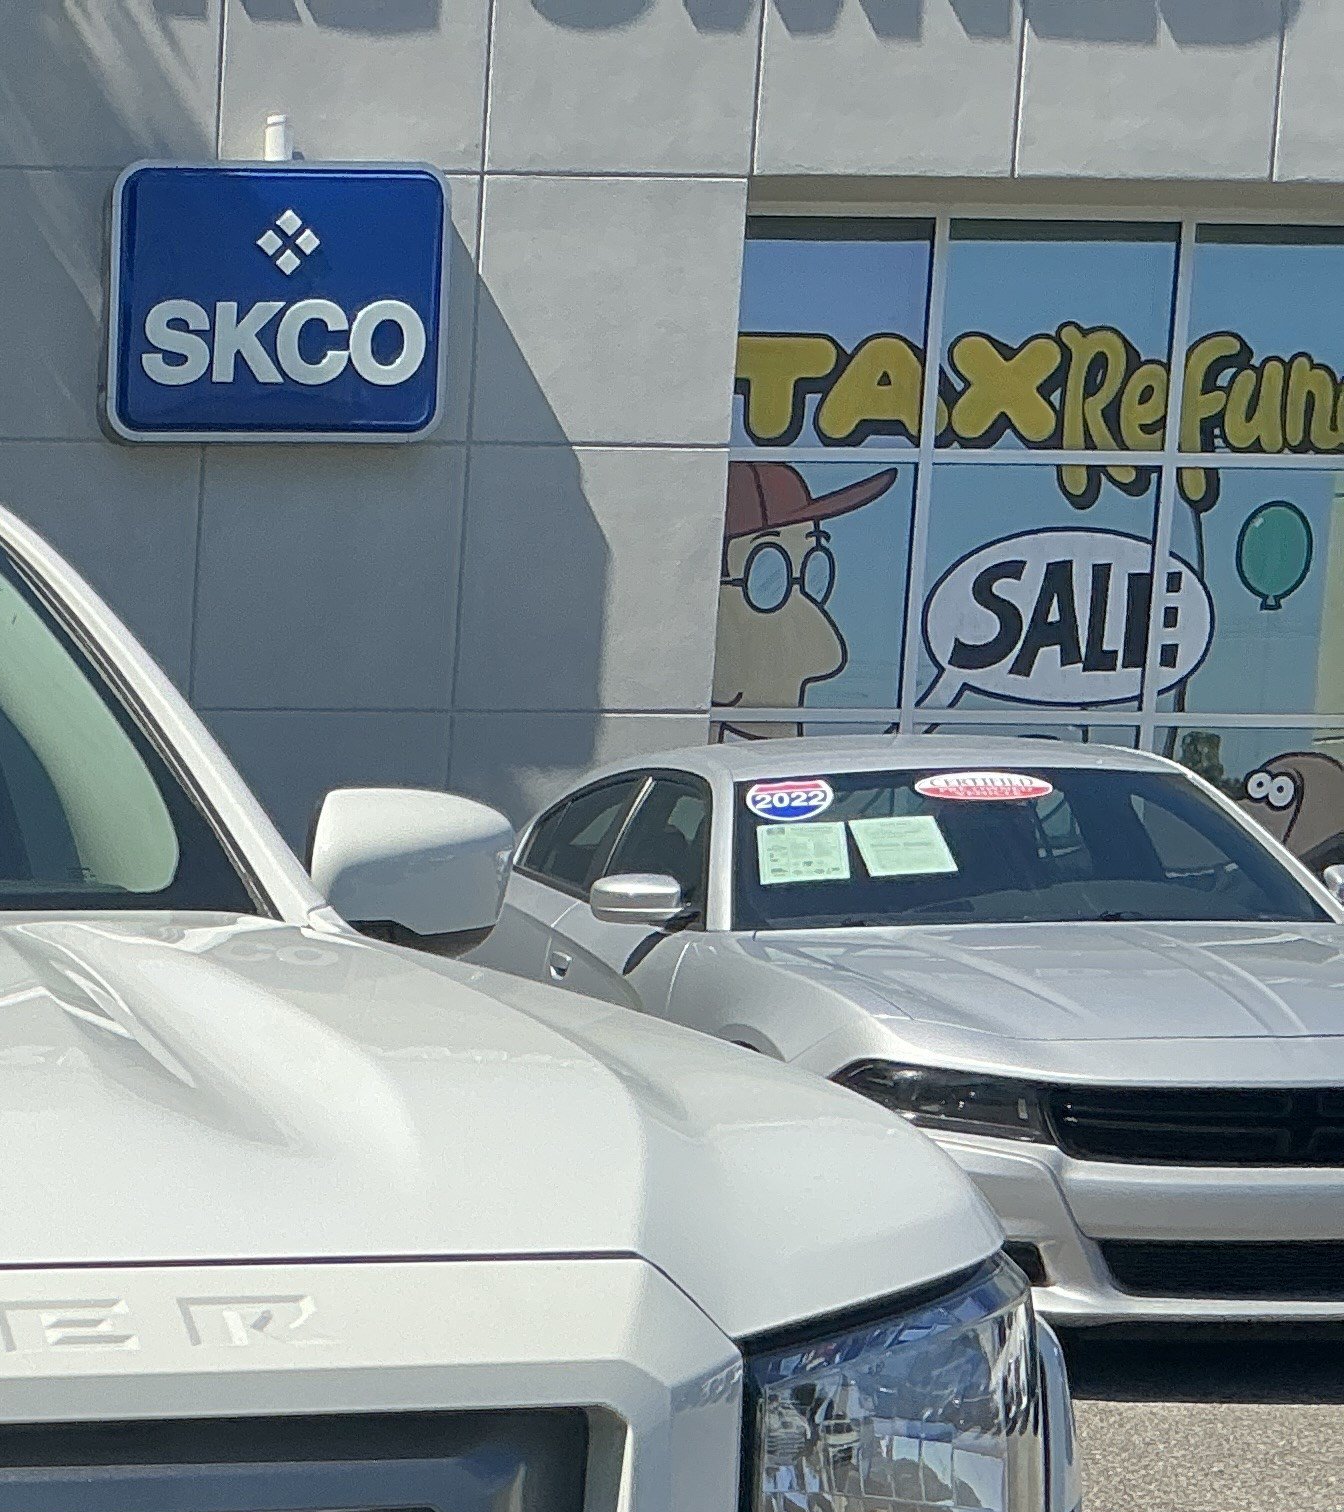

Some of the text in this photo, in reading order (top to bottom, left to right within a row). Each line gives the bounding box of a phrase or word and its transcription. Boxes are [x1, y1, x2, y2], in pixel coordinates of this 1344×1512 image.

[141, 299, 426, 386] SKCO
[734, 322, 1344, 509] TAX Refun
[948, 559, 1183, 678] SALE
[755, 791, 826, 809] 2022
